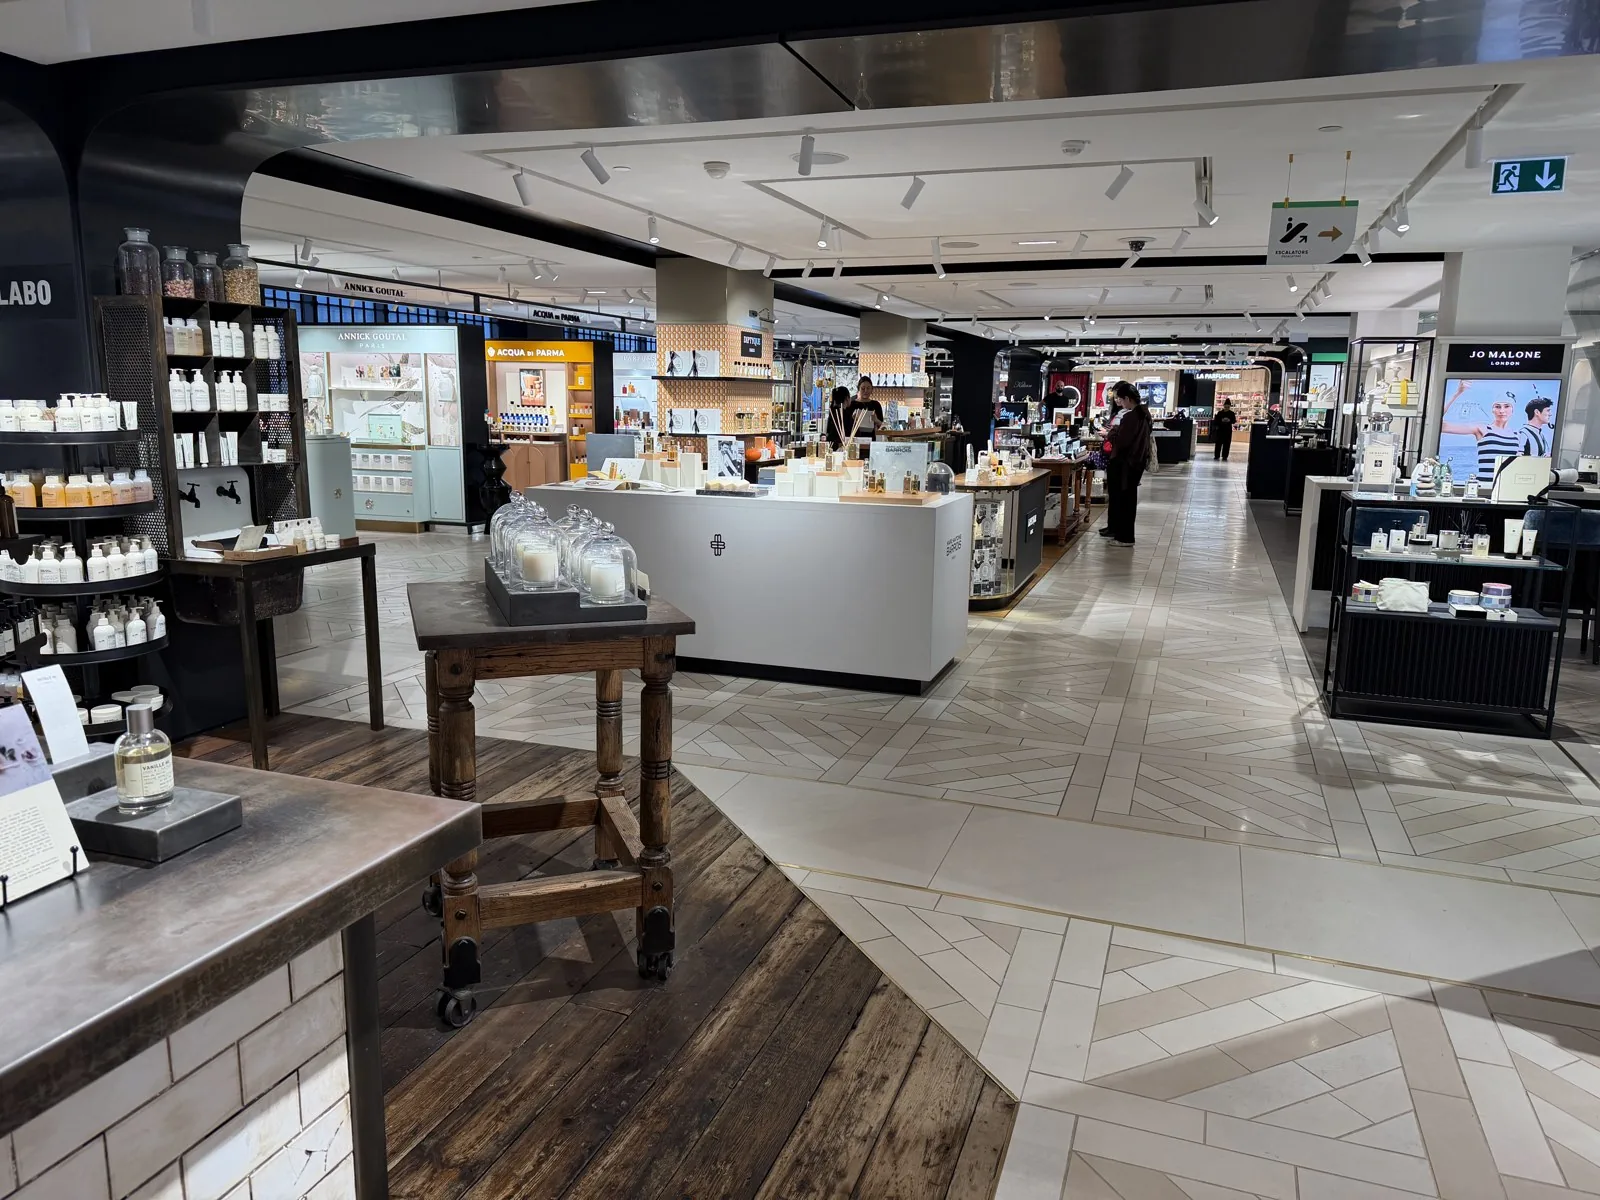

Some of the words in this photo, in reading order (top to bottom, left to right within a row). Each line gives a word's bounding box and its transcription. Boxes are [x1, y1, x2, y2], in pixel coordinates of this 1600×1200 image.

[344, 282, 374, 294] ANNICK
[375, 287, 405, 297] GOUTAL
[533, 309, 554, 320] ACQUA
[561, 313, 581, 323] PARMA
[338, 332, 371, 341] ANNICK
[372, 333, 406, 341] GOUTAL
[497, 348, 525, 357] ACQUA
[536, 349, 565, 357] PARMA
[1469, 350, 1485, 358] JO
[1488, 350, 1542, 359] MALONE
[142, 761, 165, 771] VANILLE
